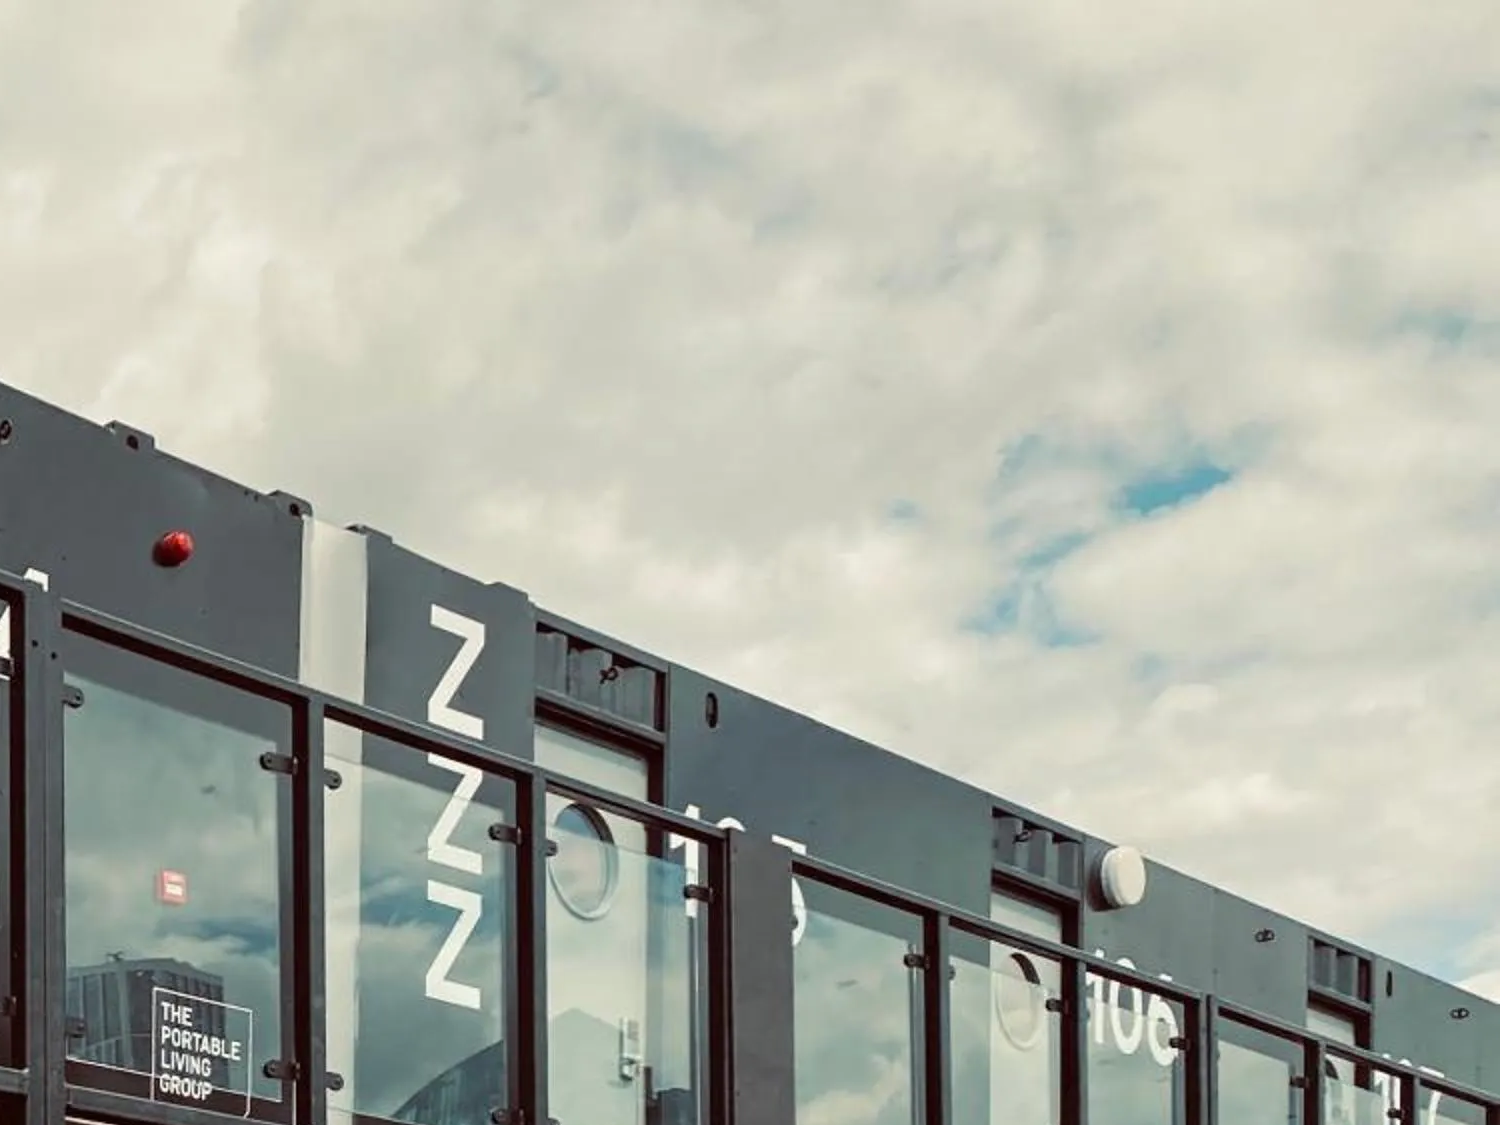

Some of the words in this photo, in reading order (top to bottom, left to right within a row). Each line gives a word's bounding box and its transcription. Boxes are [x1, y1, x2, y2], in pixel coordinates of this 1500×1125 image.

[161, 1001, 193, 1027] THE
[161, 1025, 241, 1061] PORTABLE
[161, 1048, 212, 1077] LIVING
[160, 1073, 213, 1101] GROUP
